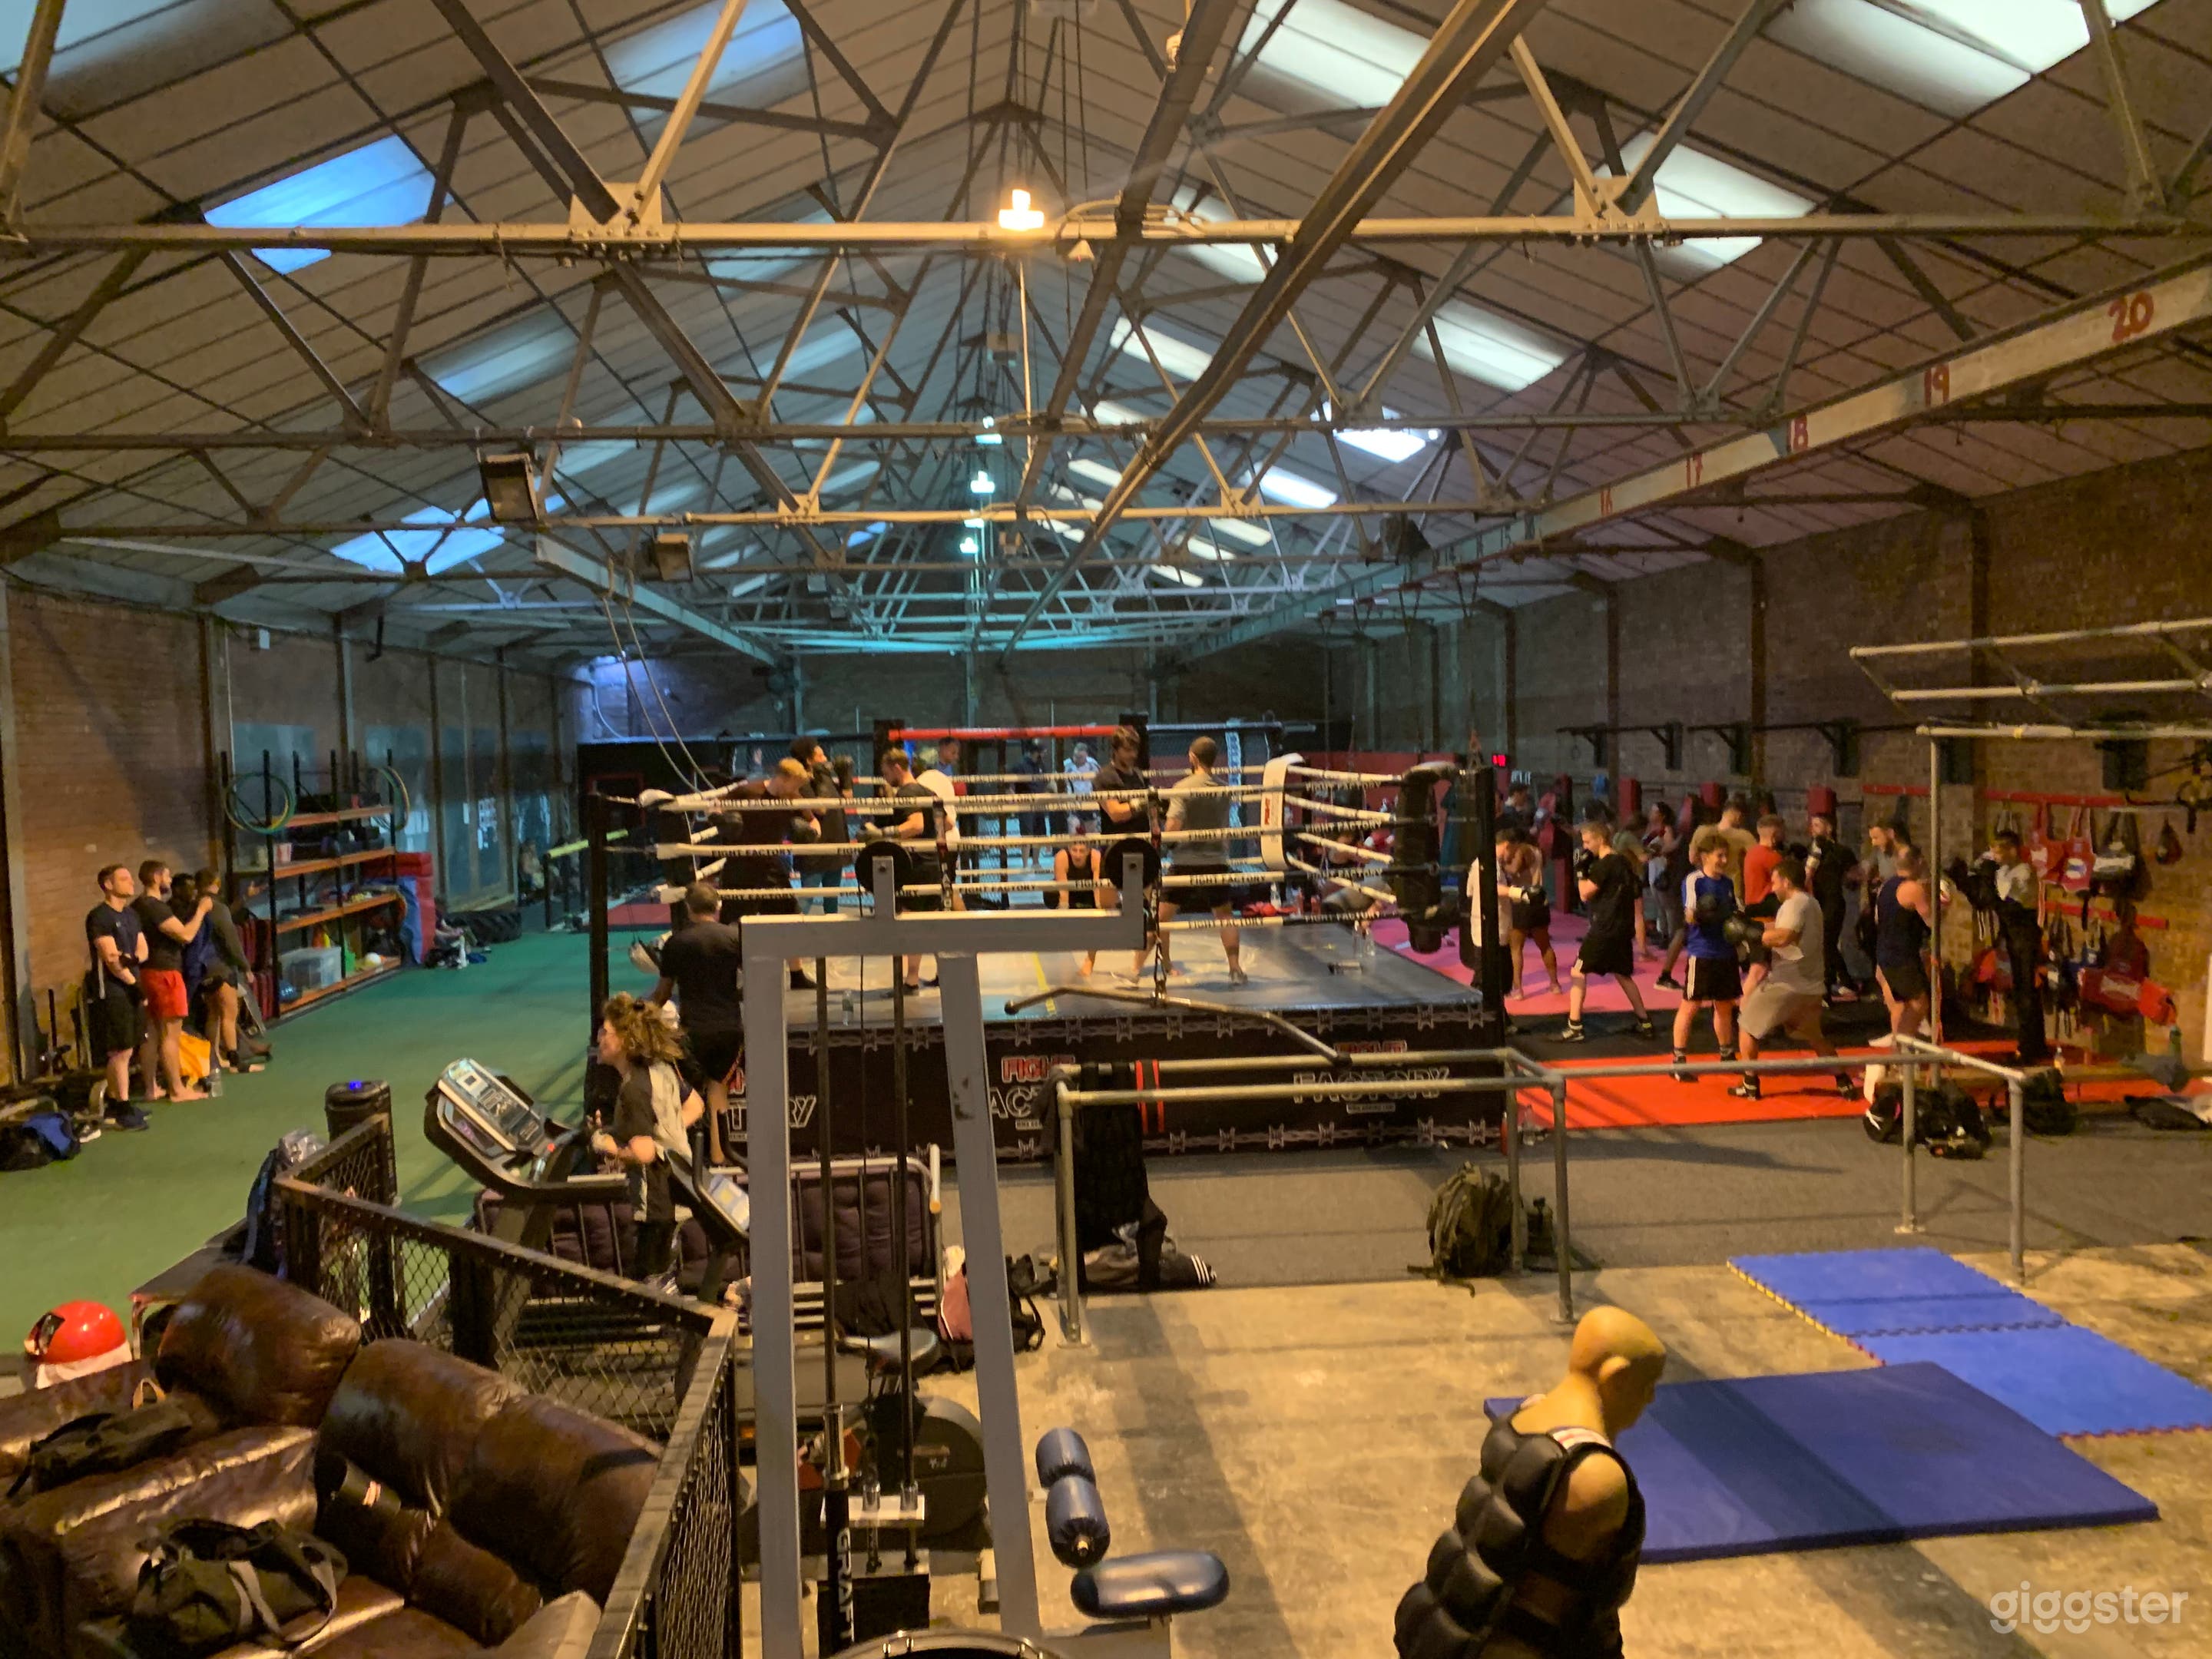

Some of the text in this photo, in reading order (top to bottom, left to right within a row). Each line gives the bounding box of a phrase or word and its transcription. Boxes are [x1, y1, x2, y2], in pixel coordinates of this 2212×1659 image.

[2107, 290, 2154, 343] 20
[1923, 363, 1951, 408] 19
[1787, 414, 1809, 454] 18
[1685, 452, 1704, 490] 17
[1305, 819, 1382, 833] FIGHT FACTORY
[1189, 830, 1264, 841] FIGHT FACTORY
[711, 848, 793, 857] FIGHT FACTORY
[1338, 867, 1383, 878] FACTORY
[1222, 875, 1266, 884] FACTORY
[1189, 917, 1263, 928] FIGHT FACTORY
